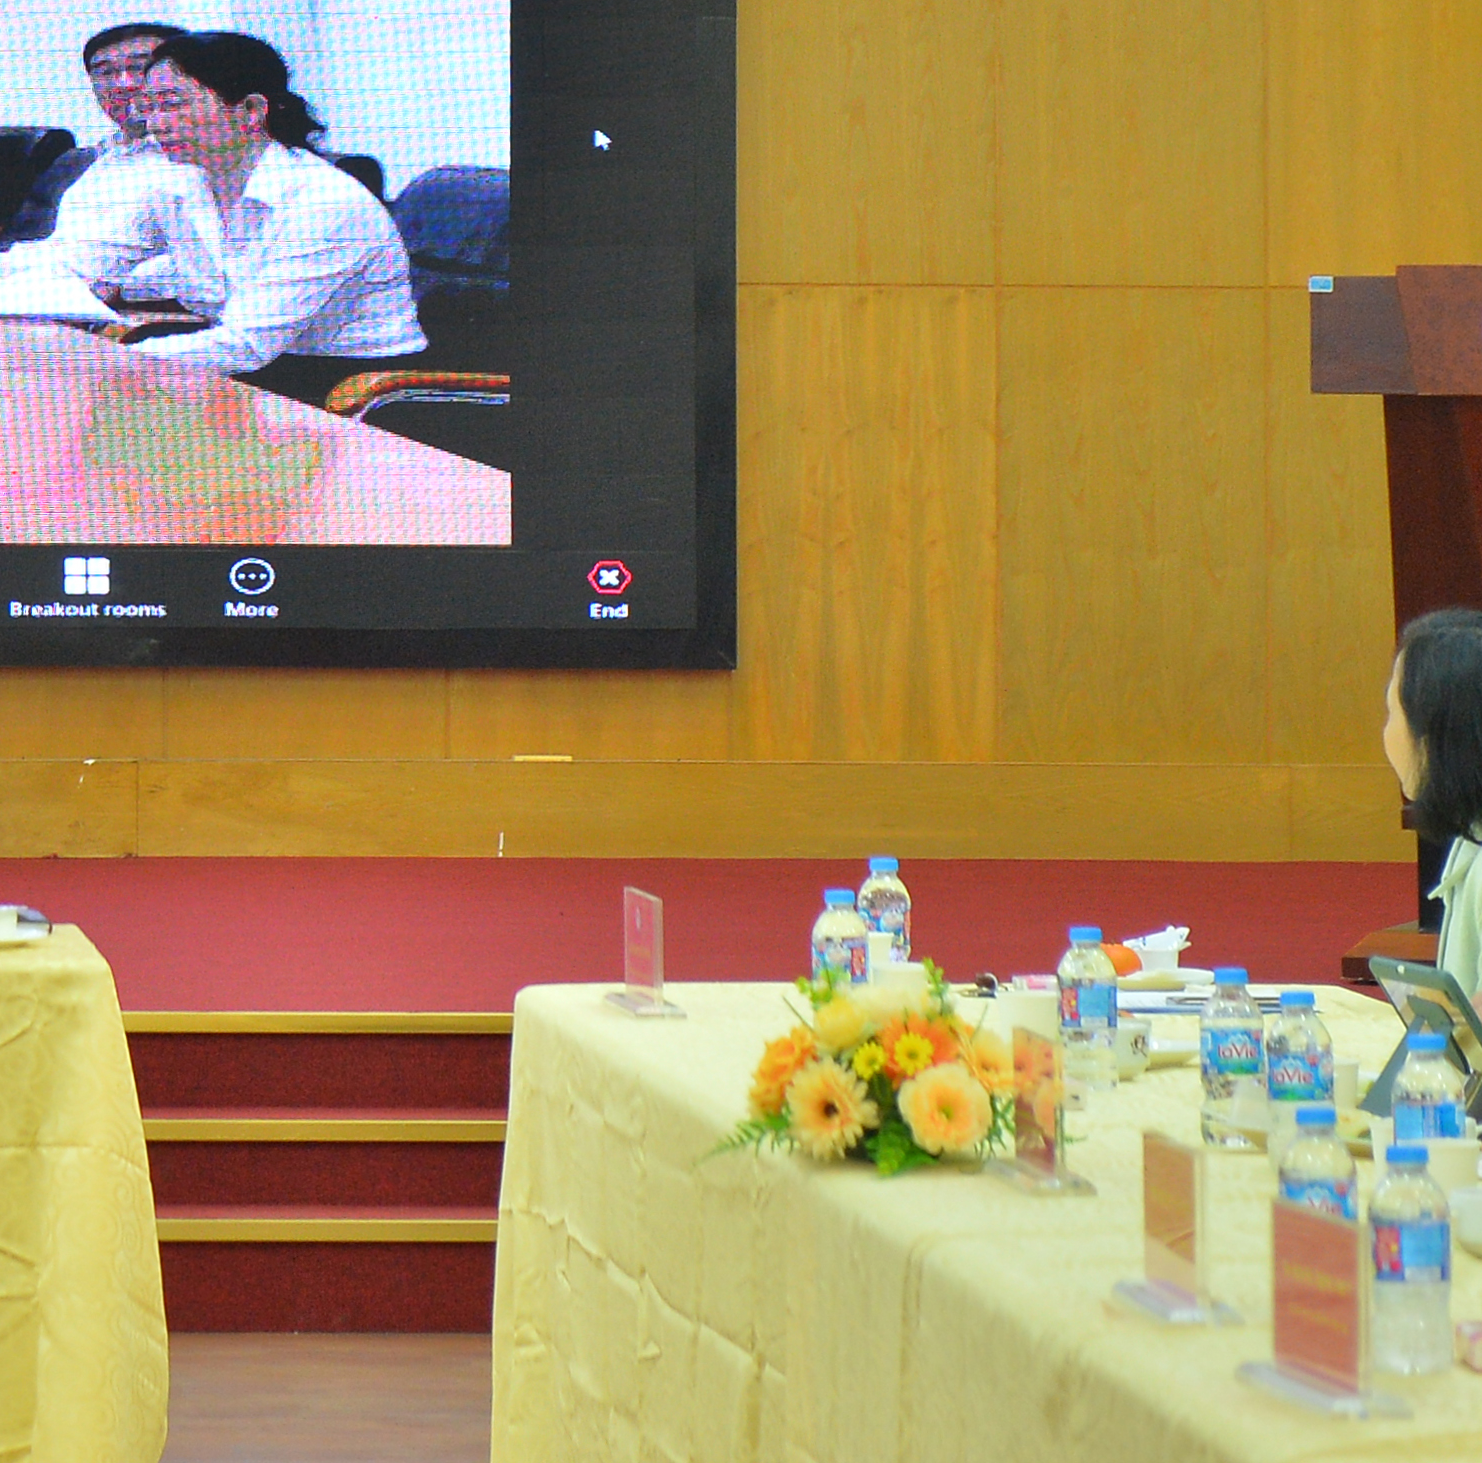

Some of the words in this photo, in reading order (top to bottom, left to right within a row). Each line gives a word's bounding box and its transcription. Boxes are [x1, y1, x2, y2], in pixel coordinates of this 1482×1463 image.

[9, 600, 99, 617] Breakout
[103, 604, 168, 618] rooms
[224, 602, 279, 618] More
[589, 602, 629, 620] End
